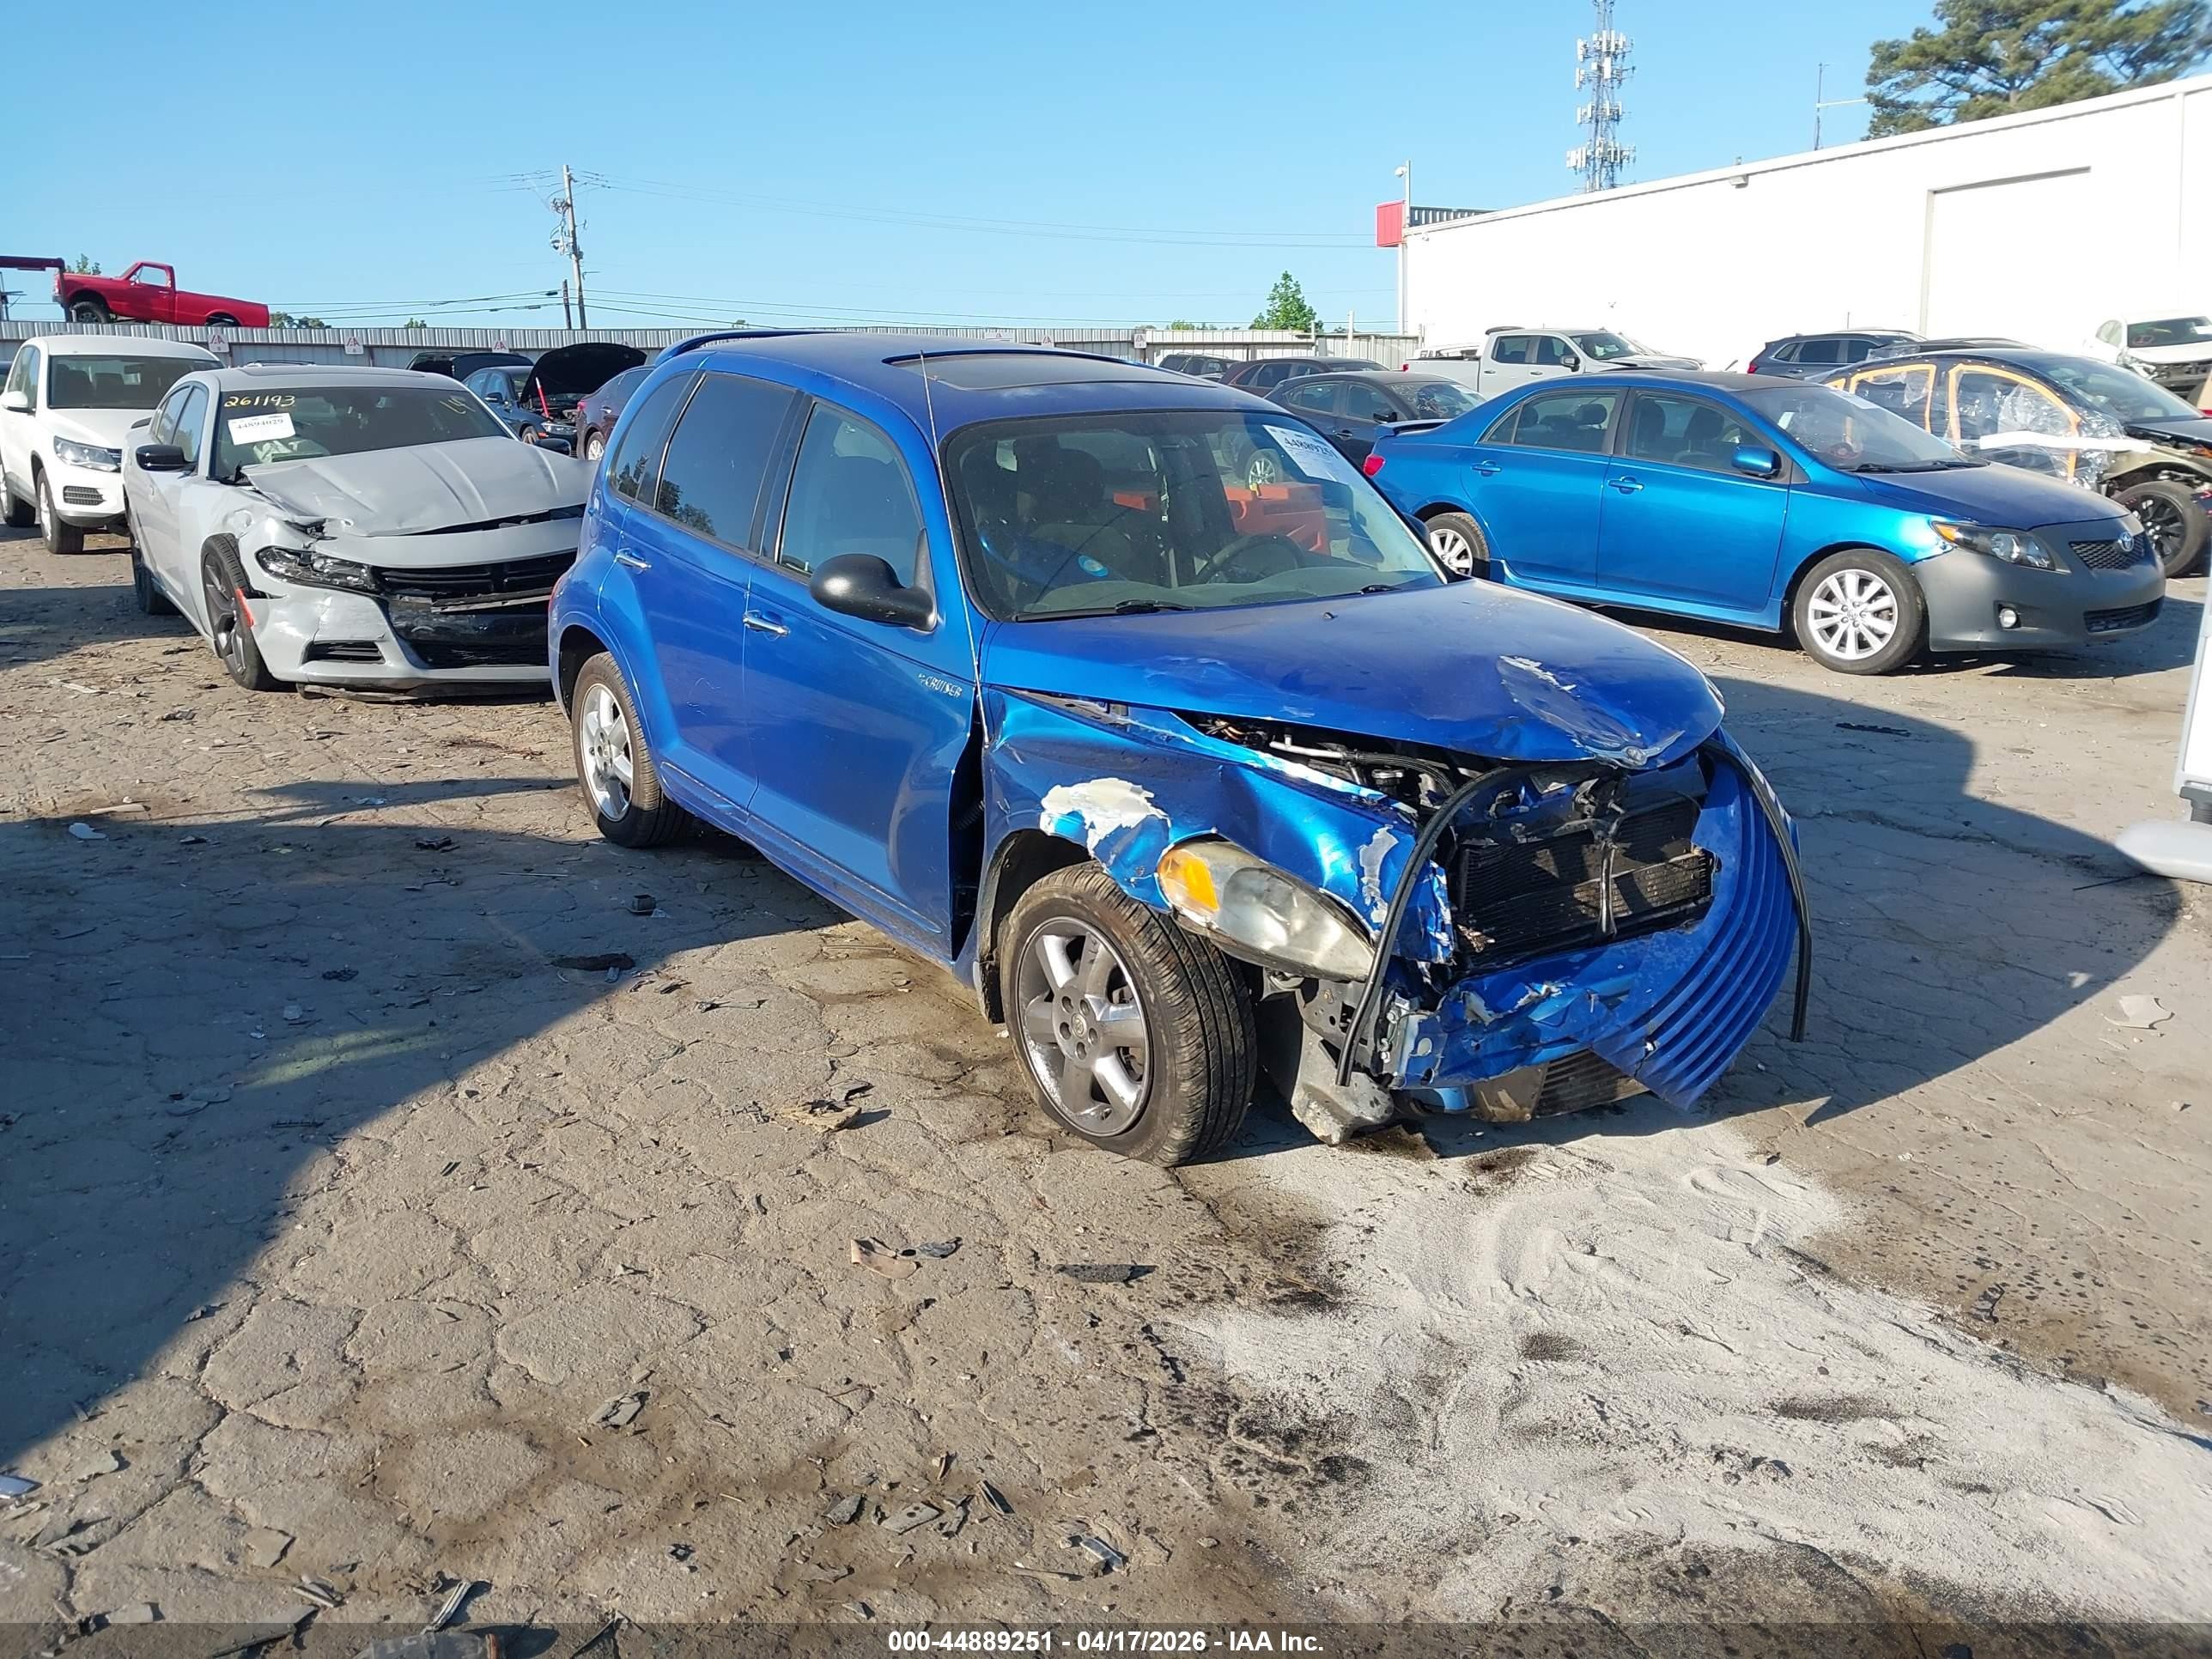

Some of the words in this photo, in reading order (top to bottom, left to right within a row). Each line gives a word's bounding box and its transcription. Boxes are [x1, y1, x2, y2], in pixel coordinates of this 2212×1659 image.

[223, 395, 295, 408] 261193
[1284, 436, 1339, 459] 44889251
[926, 676, 963, 697] CRUISER
